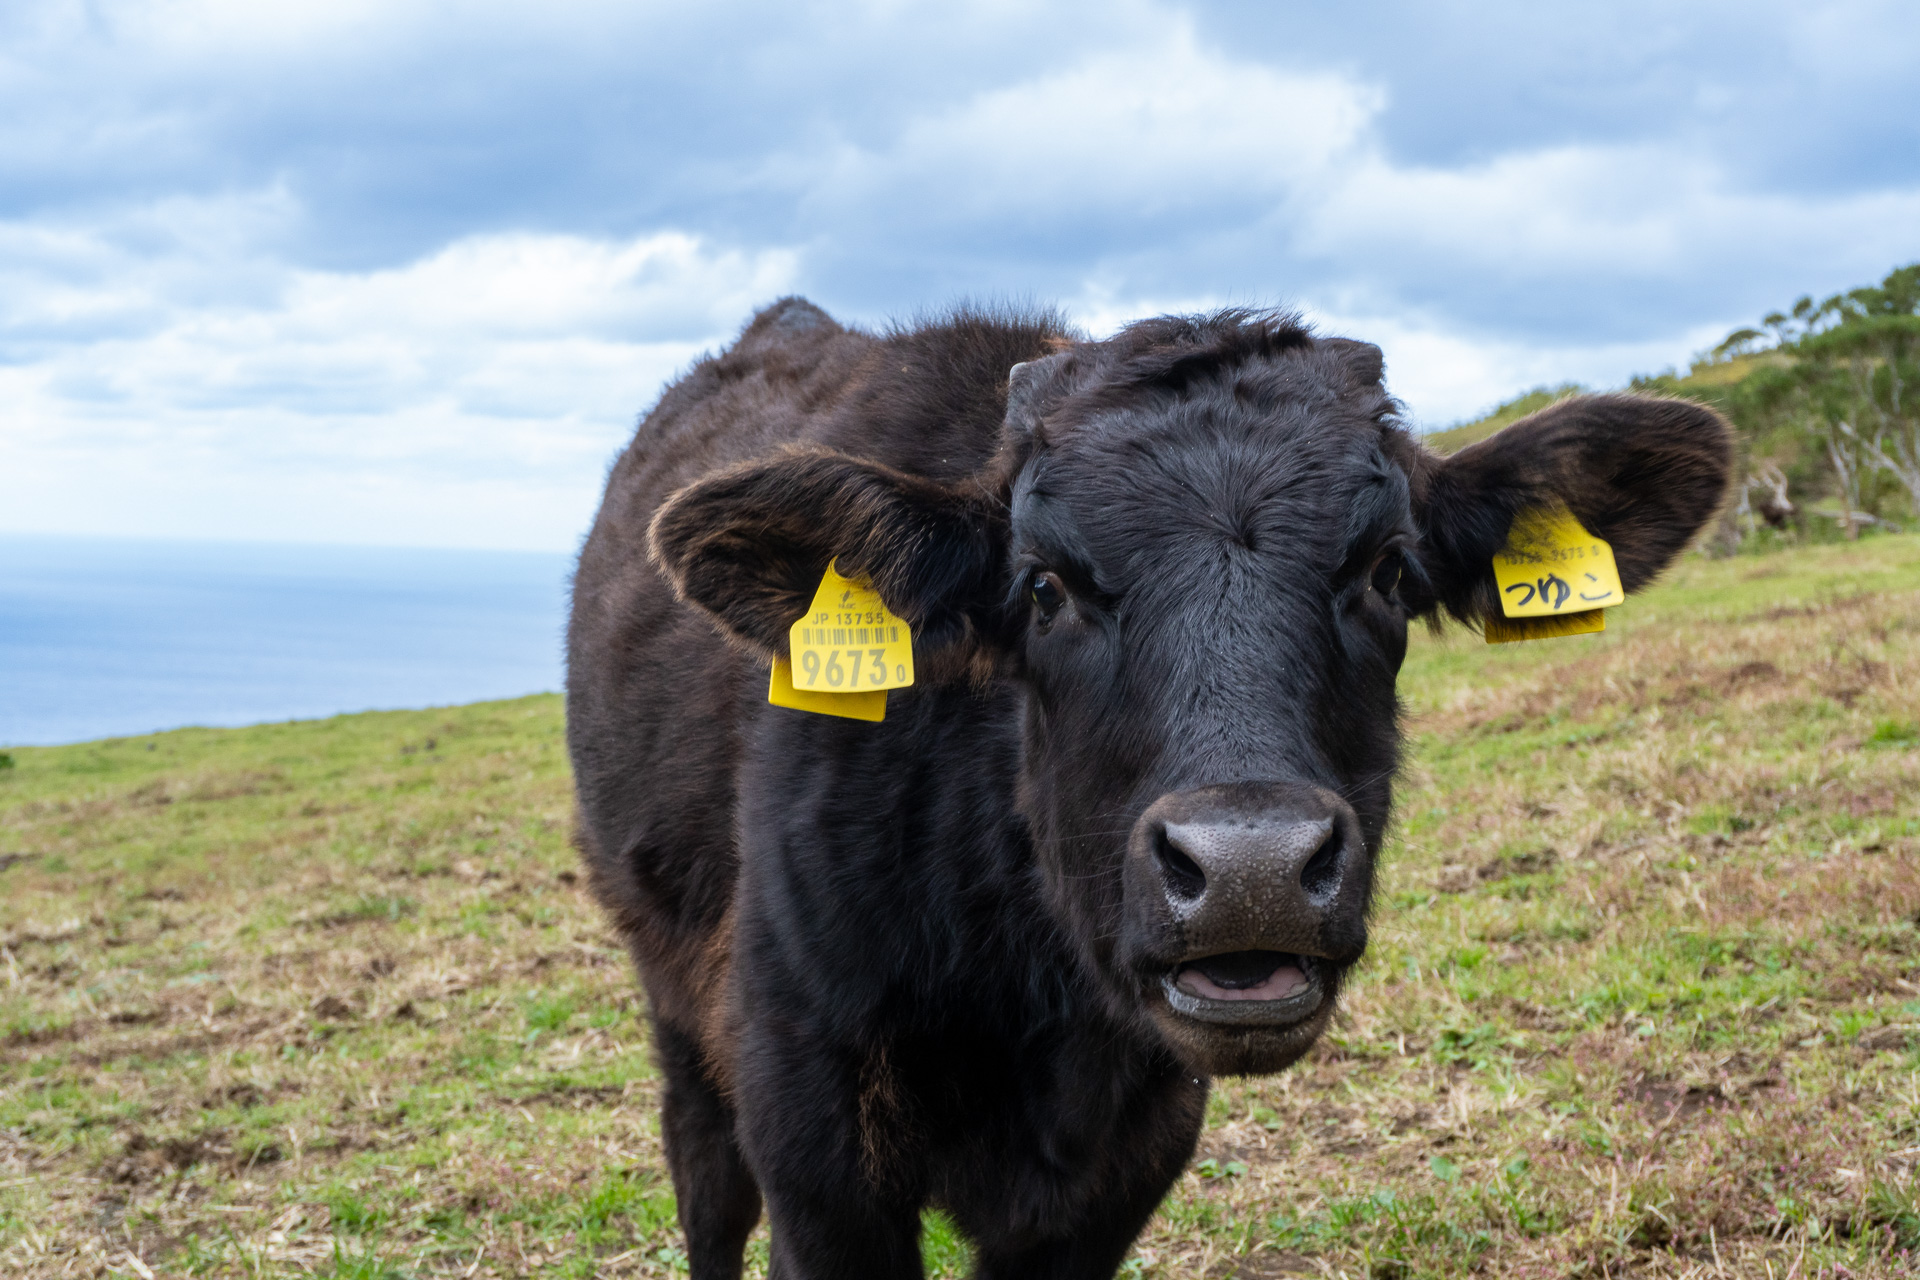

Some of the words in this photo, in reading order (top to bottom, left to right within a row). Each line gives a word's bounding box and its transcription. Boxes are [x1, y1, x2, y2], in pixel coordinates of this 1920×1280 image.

[1505, 572, 1613, 610] つゆこ
[812, 613, 829, 625] JP
[802, 648, 887, 687] 9673
[895, 664, 906, 683] 0
